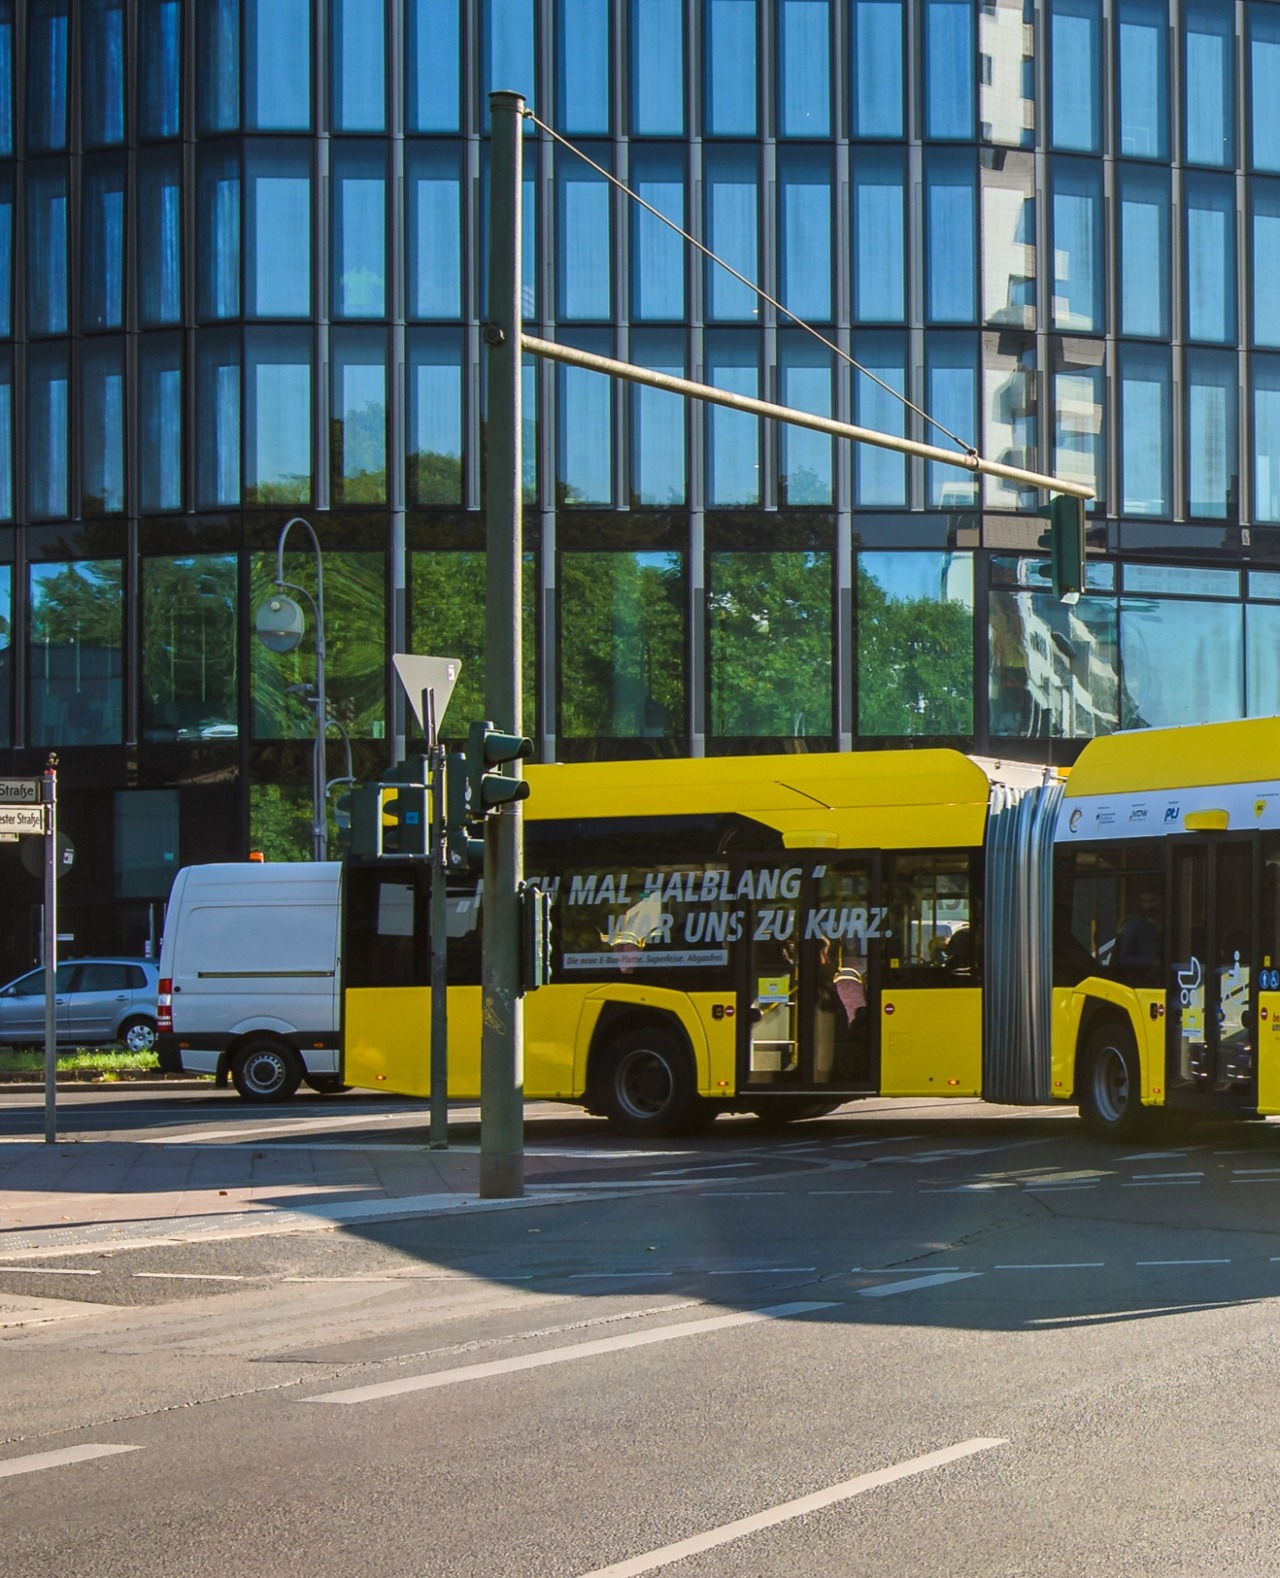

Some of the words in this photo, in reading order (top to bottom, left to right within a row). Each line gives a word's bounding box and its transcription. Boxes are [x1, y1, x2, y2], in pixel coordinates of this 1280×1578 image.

[17, 812, 40, 827] Straße
[568, 874, 632, 906] MAL
[606, 913, 674, 945] WAR
[684, 910, 746, 943] UNS
[752, 909, 796, 941] ZU
[804, 907, 893, 940] KURZ.
